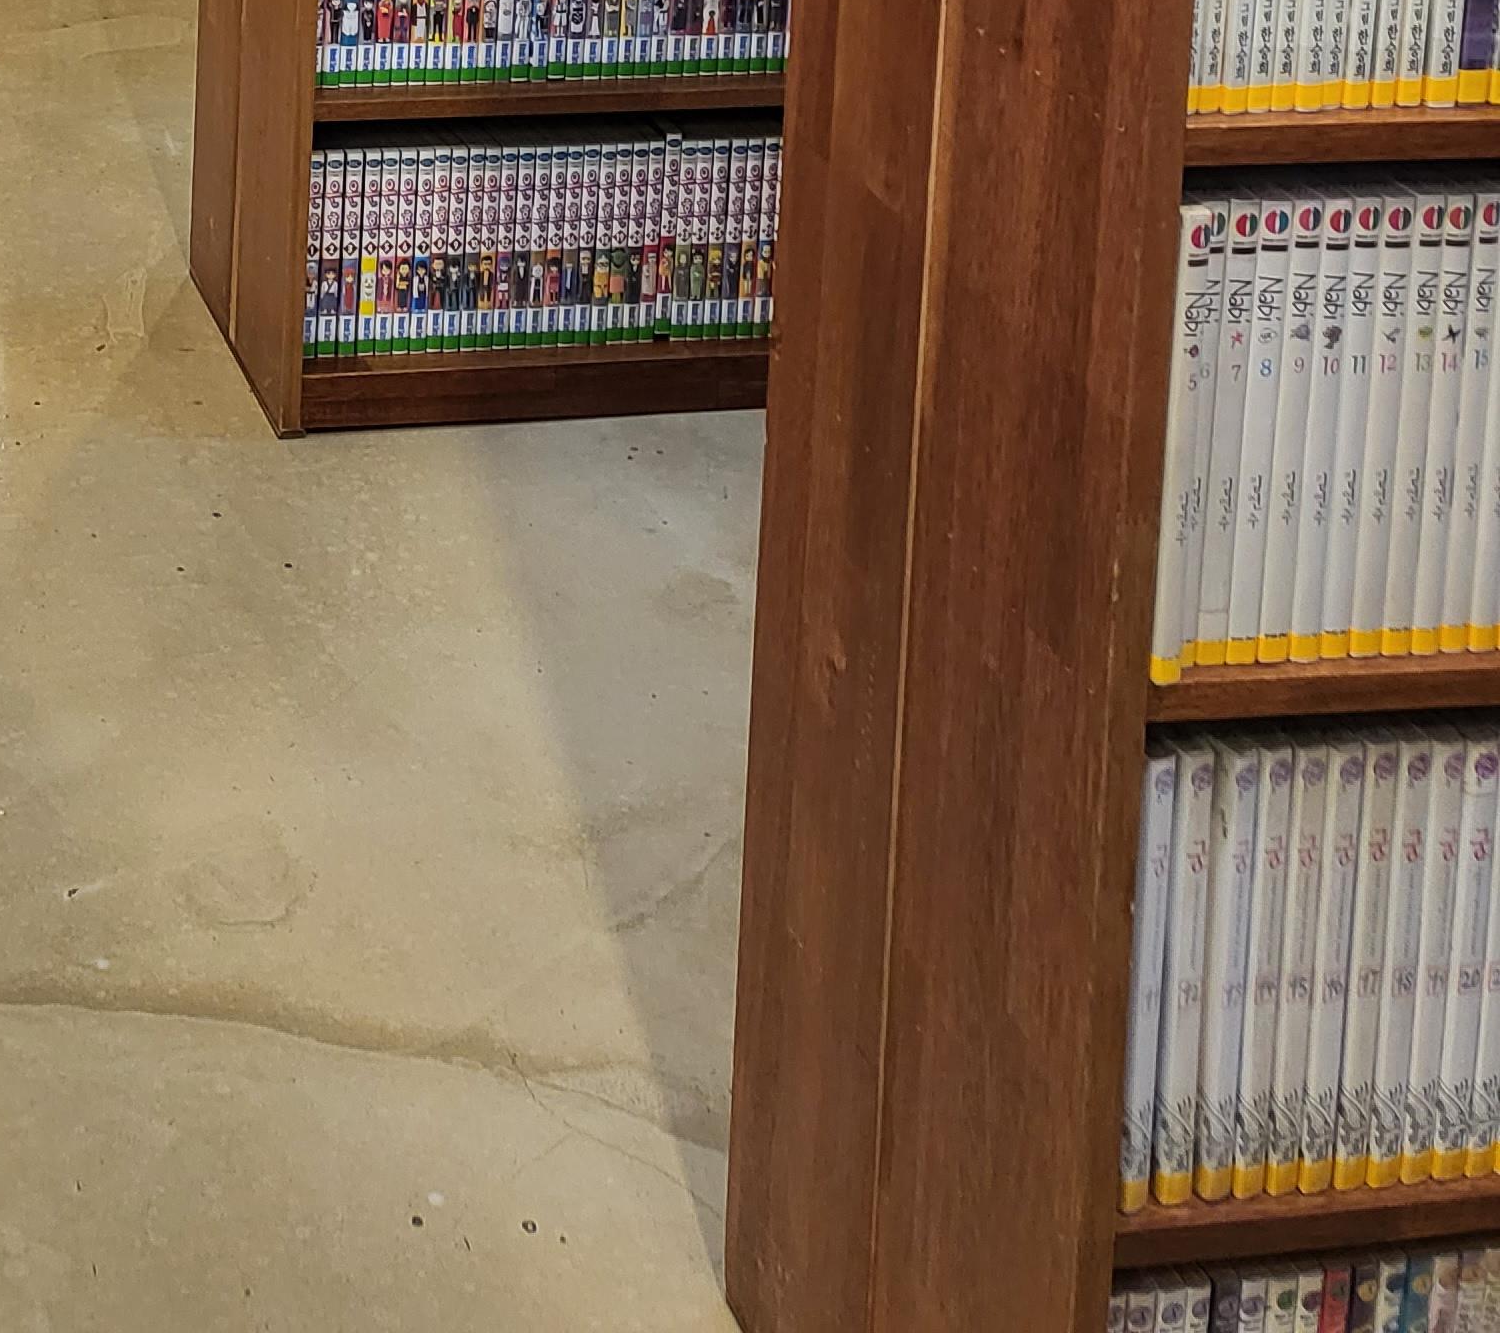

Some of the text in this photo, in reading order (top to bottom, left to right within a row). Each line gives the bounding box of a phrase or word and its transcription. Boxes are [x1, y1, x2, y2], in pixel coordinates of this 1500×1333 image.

[1185, 292, 1220, 391] Nabi 5
[1228, 279, 1253, 382] Nabi 7
[1257, 276, 1284, 377] Nabi 8
[1292, 273, 1317, 373] Nabi 9
[1323, 275, 1347, 376] Nabi 10
[1352, 271, 1375, 374] Nabi 11
[1380, 271, 1407, 374] Nabi 12
[1442, 270, 1467, 374] Nabi 14
[1474, 268, 1497, 371] Nabi 15
